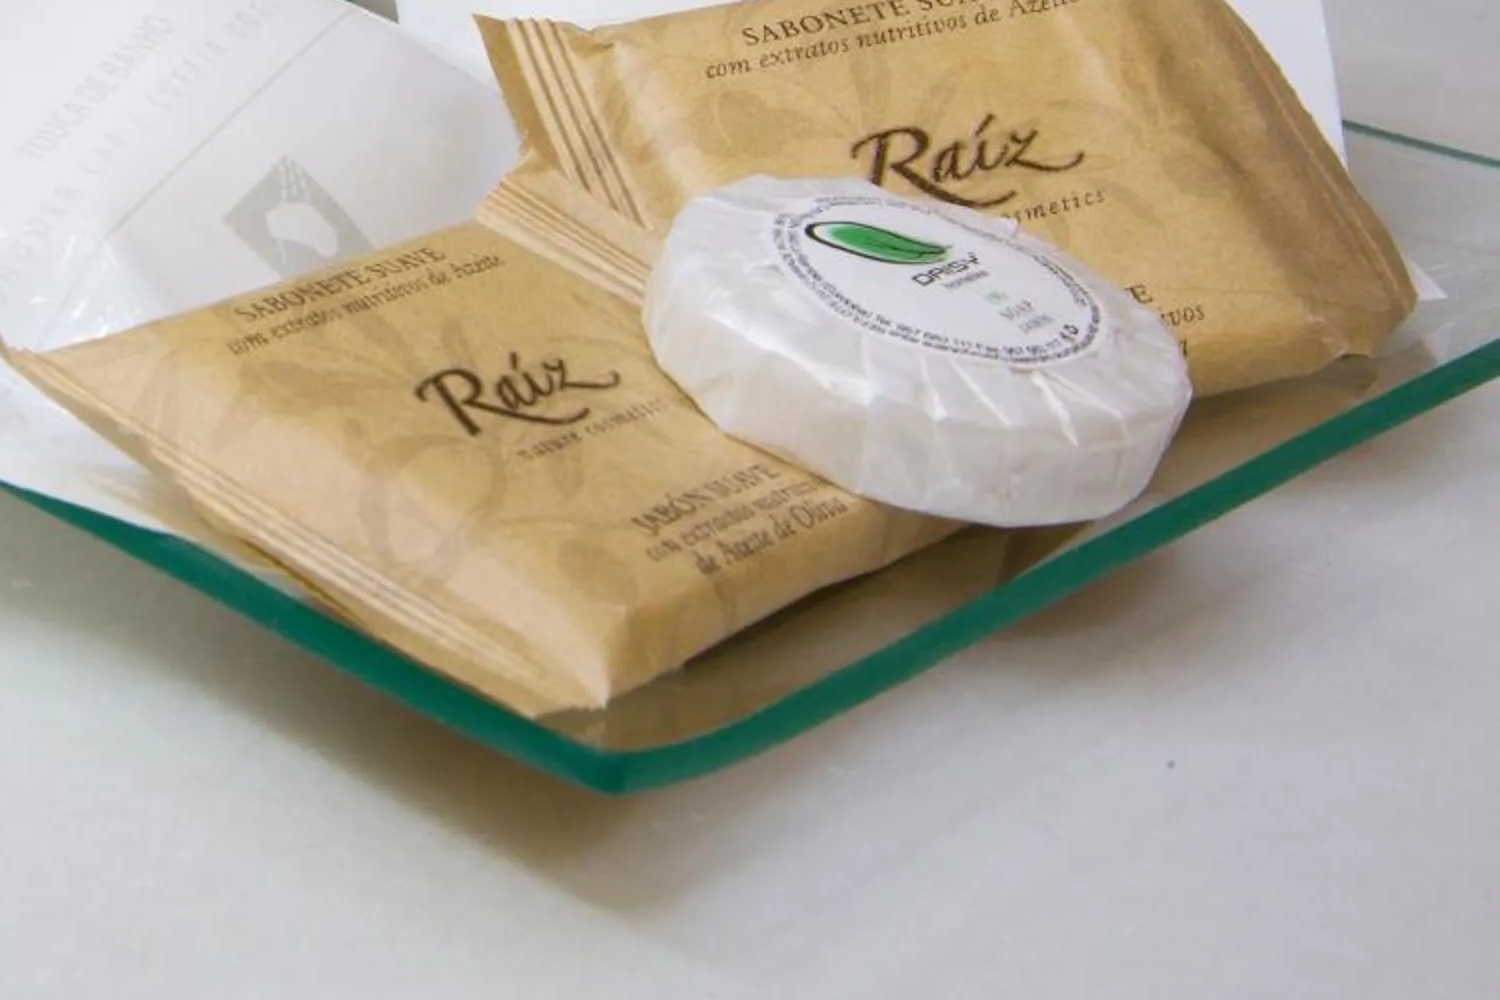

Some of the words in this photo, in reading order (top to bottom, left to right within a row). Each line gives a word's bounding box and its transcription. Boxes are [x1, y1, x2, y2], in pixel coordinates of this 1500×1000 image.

[705, 56, 751, 80] com
[758, 36, 851, 69] extratos
[856, 11, 968, 50] nutritivos
[973, 4, 1001, 27] de
[850, 112, 1085, 208] Raíz
[235, 266, 371, 322] SABONETE
[363, 247, 446, 282] SUAVE
[414, 351, 621, 437] Raíz
